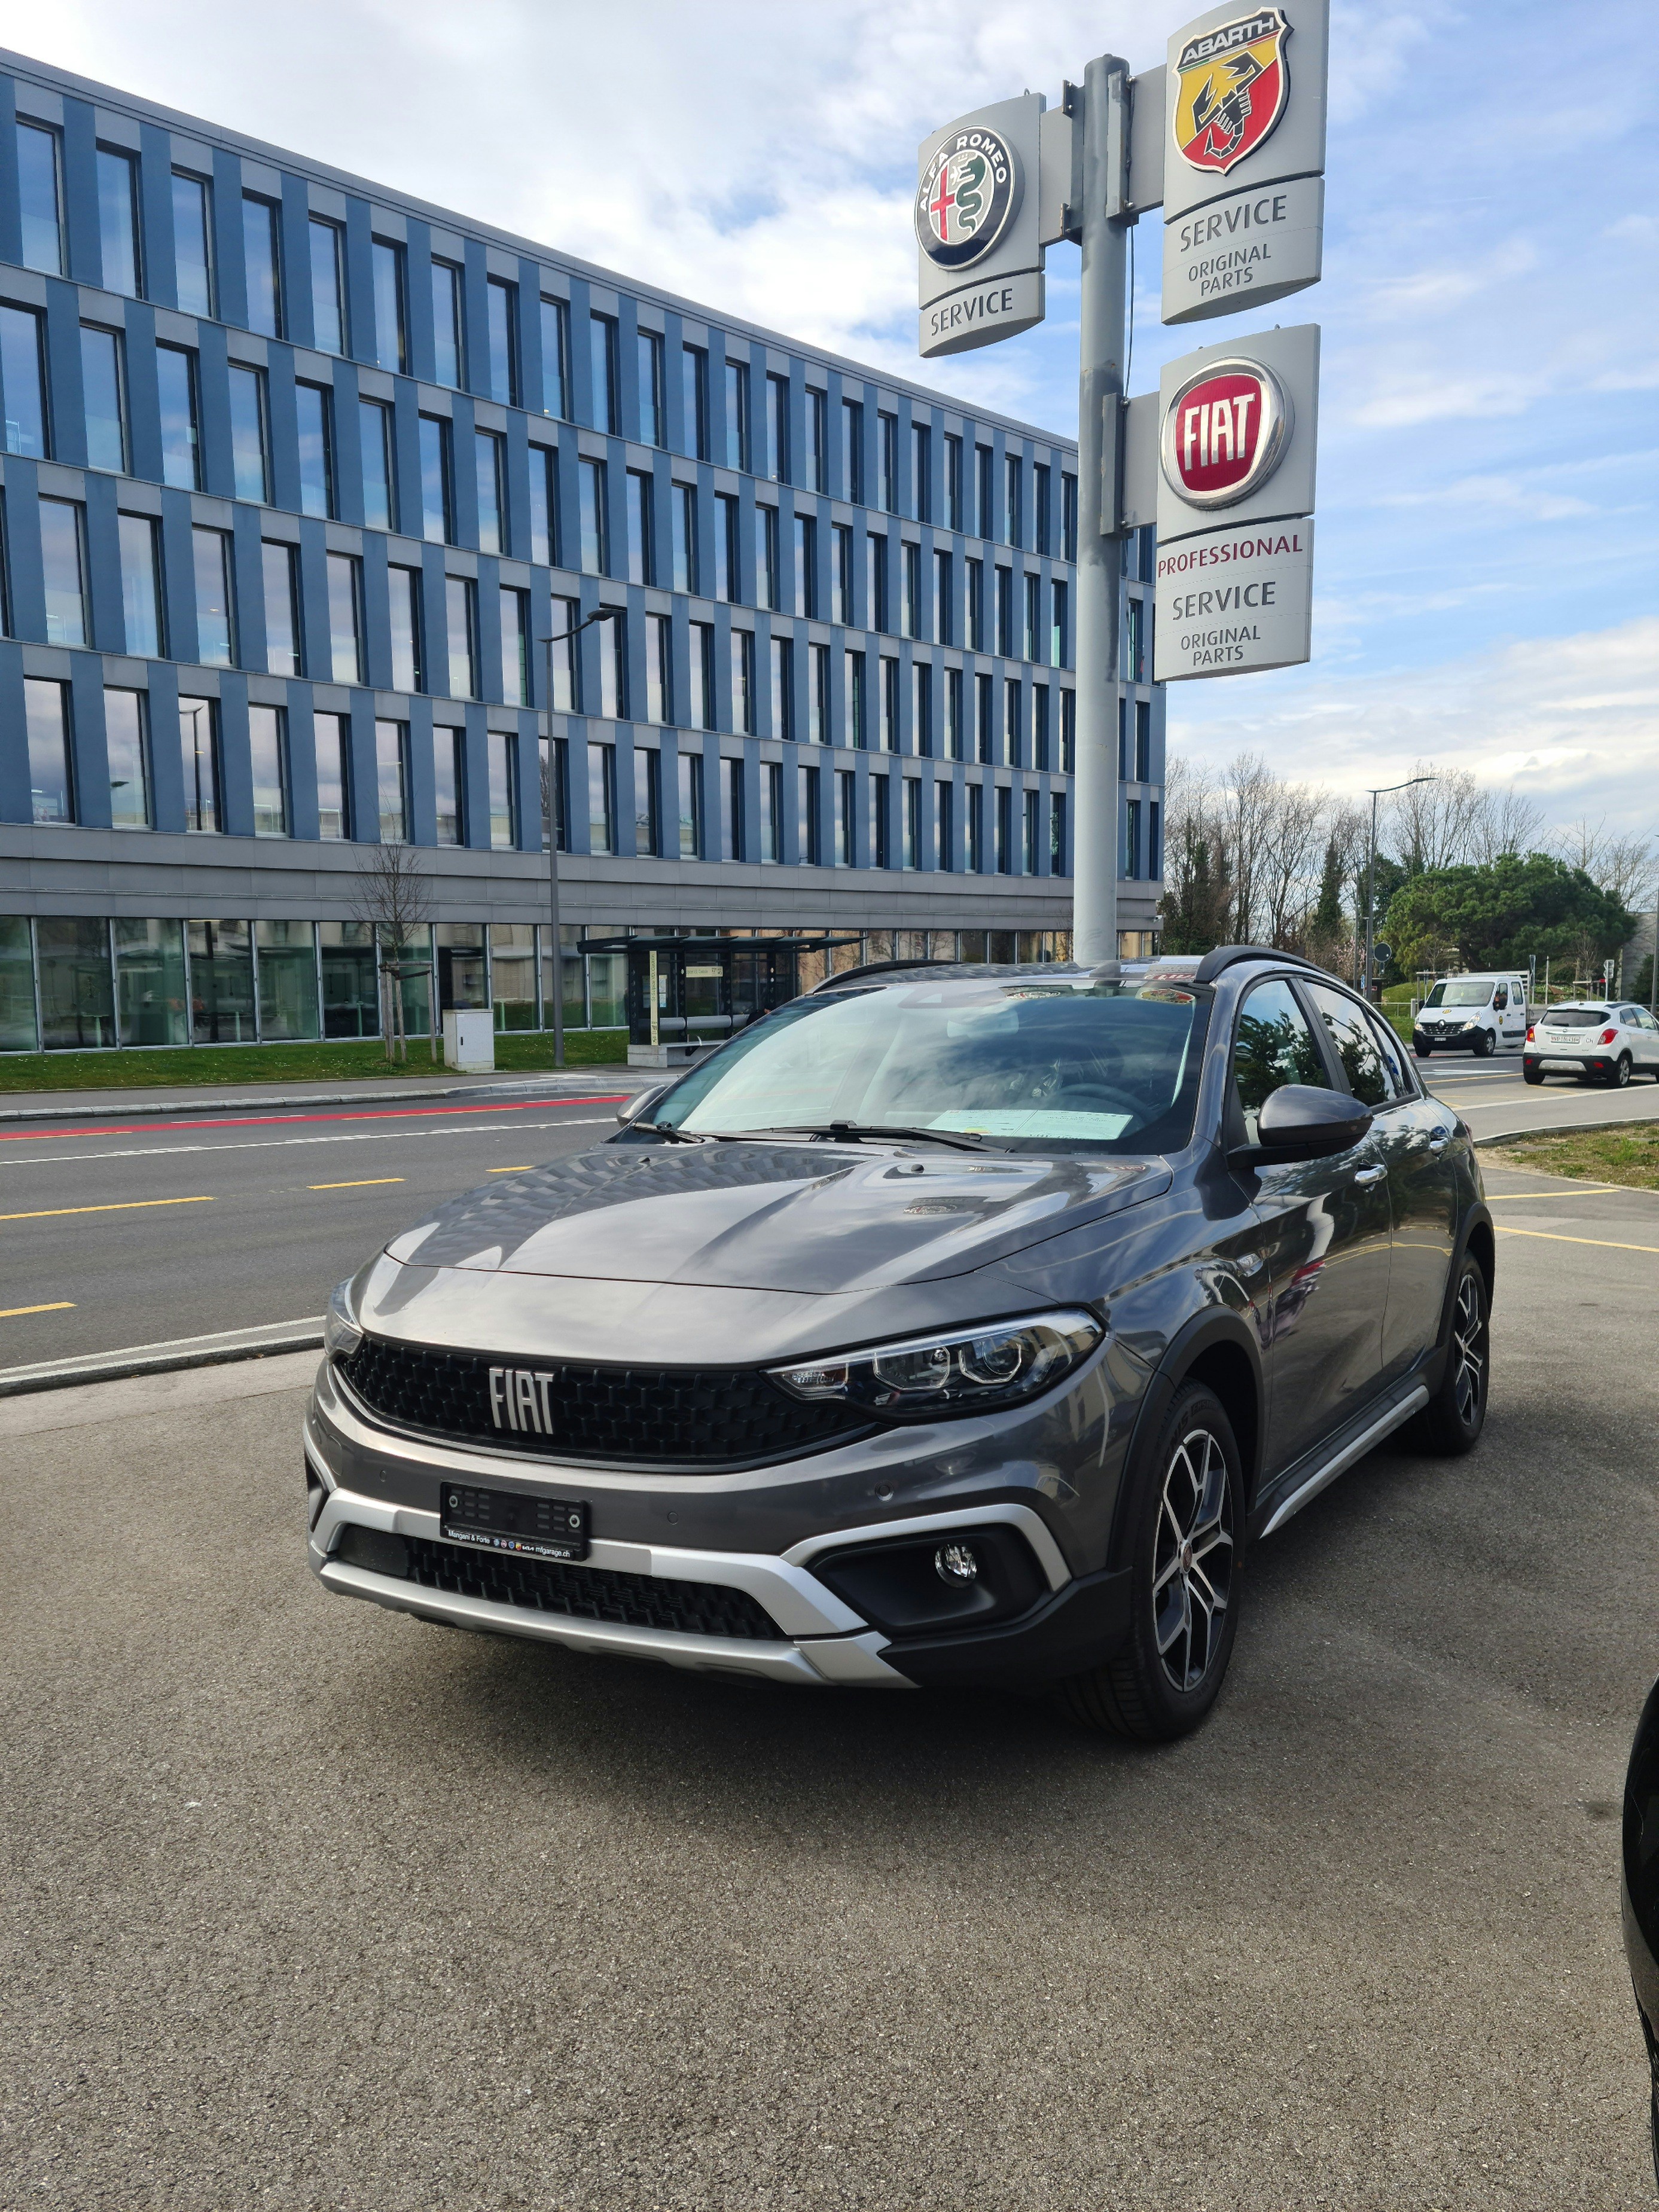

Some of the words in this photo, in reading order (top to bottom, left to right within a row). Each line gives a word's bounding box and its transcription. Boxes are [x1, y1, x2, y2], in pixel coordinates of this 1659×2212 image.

[1182, 17, 1275, 65] ABARTH
[920, 152, 949, 212] ALFA
[956, 133, 1007, 184] ROMEO
[1180, 194, 1288, 253] SERVICE
[1188, 243, 1271, 282] ORIGINAL
[1201, 266, 1254, 297] PARTS
[931, 288, 1013, 337] SERVICE
[1184, 392, 1256, 472] FIAT
[1158, 534, 1303, 578] PROFESSIONAL
[1172, 581, 1276, 621] SERVICE
[1181, 624, 1261, 651] ORIGINAL
[1193, 645, 1244, 666] PARTS
[489, 1365, 556, 1435] FIAT
[448, 1530, 470, 1540] Mangani
[476, 1535, 490, 1544] Forte
[535, 1546, 571, 1558] mfgarage.ch
